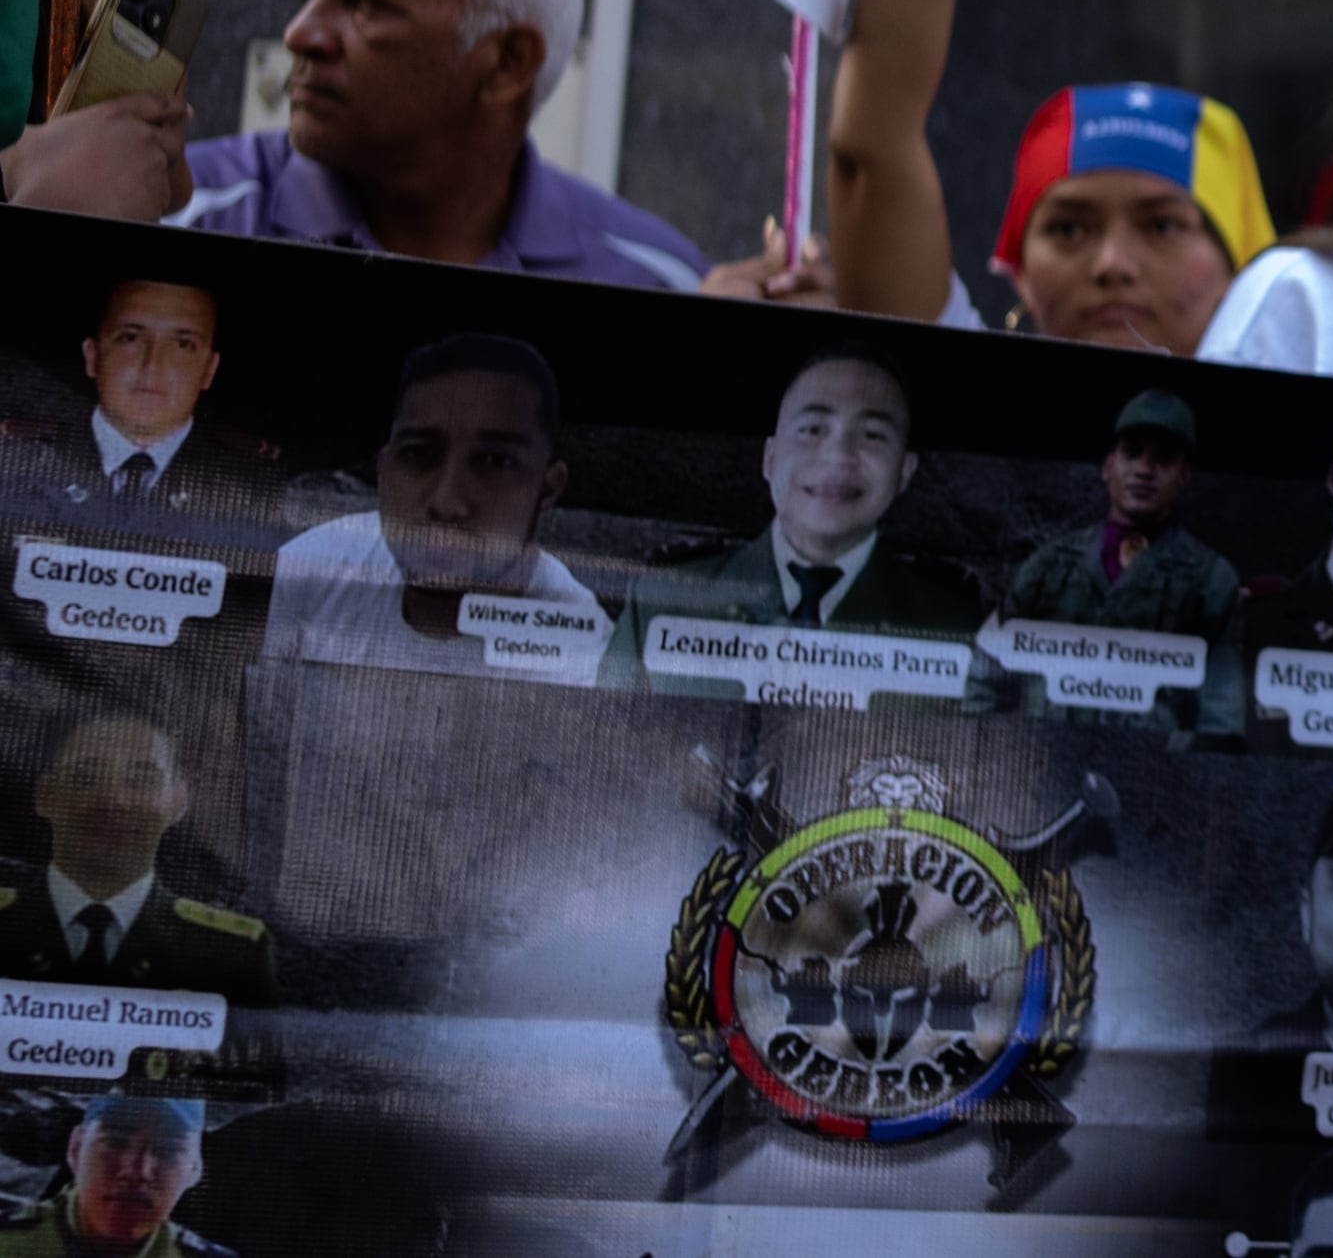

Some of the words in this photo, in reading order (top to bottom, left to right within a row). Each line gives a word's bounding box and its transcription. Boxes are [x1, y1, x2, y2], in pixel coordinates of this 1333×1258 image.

[29, 555, 118, 587] Carlos
[124, 565, 213, 597] Conde
[60, 601, 167, 636] Gedeon
[467, 601, 531, 626] Wilmer
[532, 608, 597, 633] Salinas
[493, 635, 562, 659] Gedeon
[659, 627, 768, 662] Leandro
[775, 638, 885, 671] Chirinos
[891, 648, 960, 678] Parra
[1012, 629, 1100, 660] Ricardo
[1105, 639, 1196, 670] Fonseca
[757, 680, 856, 708] Gedeon
[1059, 673, 1144, 704] Gedeon
[760, 836, 1011, 935] OPERACION
[0, 992, 111, 1024] Manuel
[118, 1000, 215, 1031] Ramos
[7, 1037, 116, 1069] Gedeon
